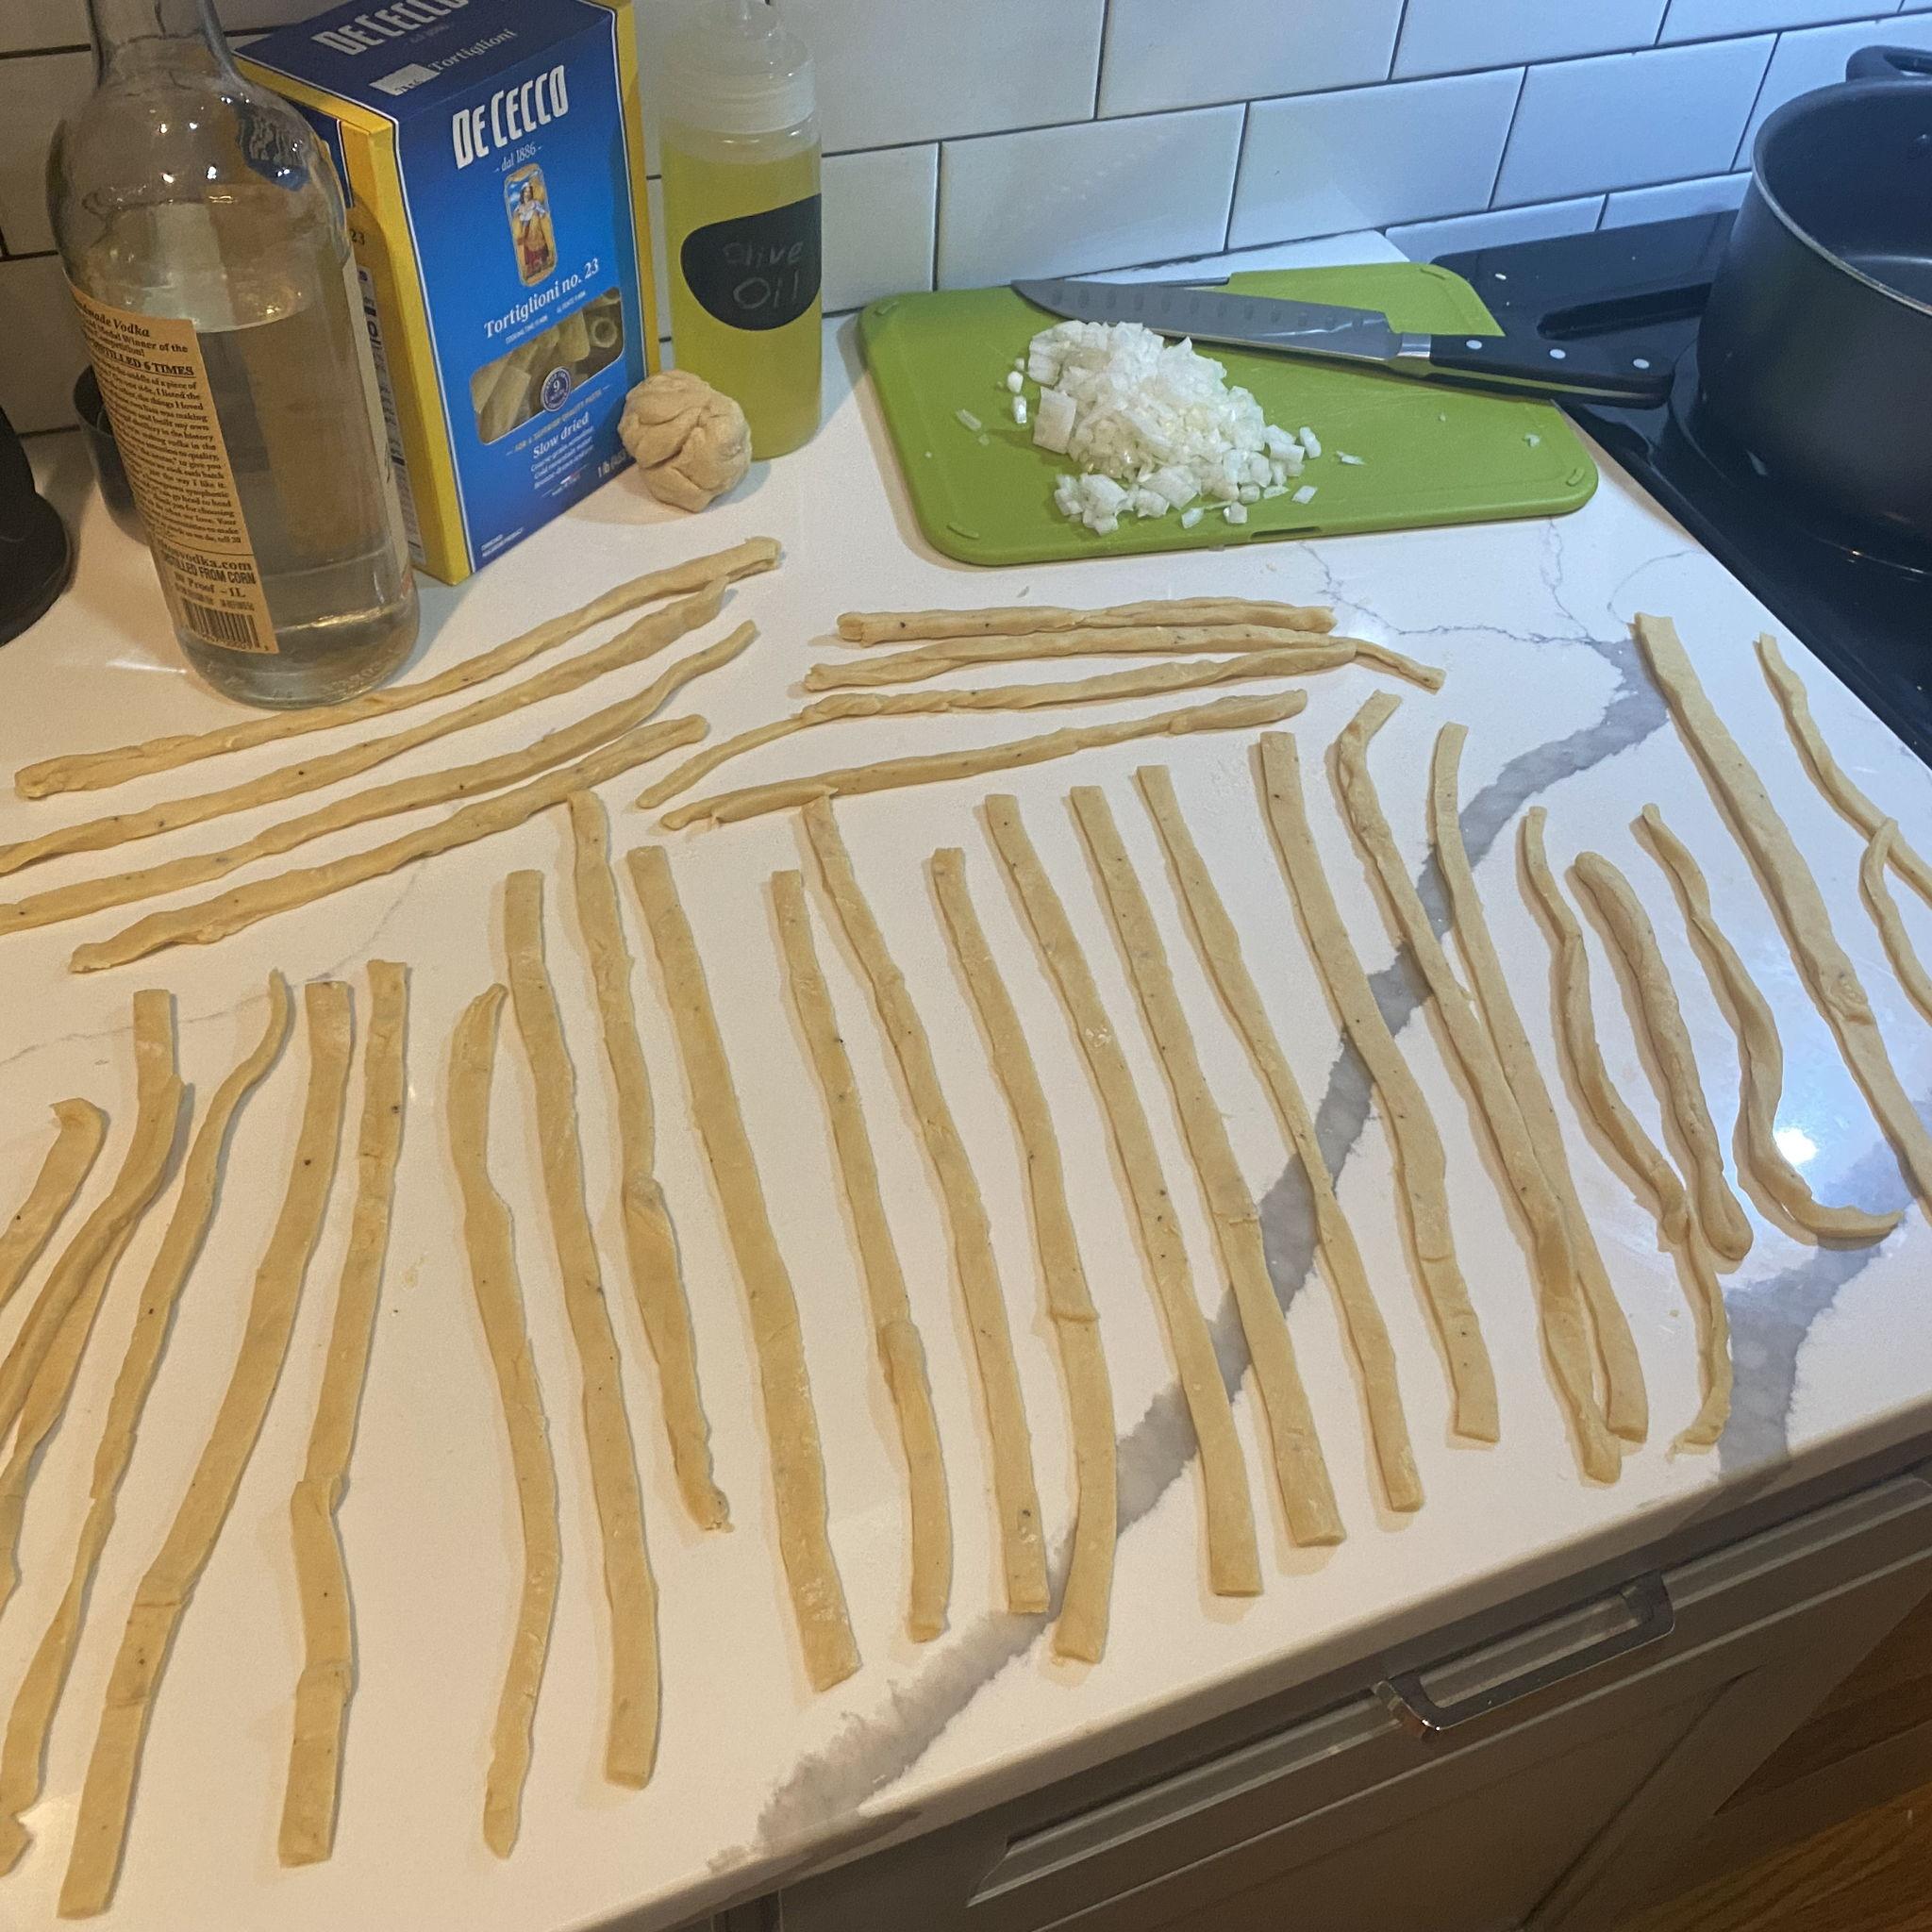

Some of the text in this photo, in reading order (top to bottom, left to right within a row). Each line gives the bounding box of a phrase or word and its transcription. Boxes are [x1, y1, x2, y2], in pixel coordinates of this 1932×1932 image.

[311, 25, 386, 56] DE
[428, 28, 517, 72] Tortiglioni
[452, 65, 569, 171] DE CECCO
[501, 142, 537, 172] dal 1886
[723, 241, 803, 268] Olive
[484, 257, 600, 339] Tortiglioni no. 23
[733, 269, 801, 309] Oil
[113, 318, 150, 338] Vodka
[122, 333, 157, 350] Winner
[158, 342, 170, 353] of
[171, 343, 189, 354] the
[142, 361, 151, 371] 6
[151, 362, 194, 376] TIMES
[553, 380, 561, 393] 9
[532, 434, 559, 459] Slow
[560, 411, 591, 441] dried
[187, 576, 215, 594] Proof
[198, 566, 226, 583] FROM
[226, 571, 257, 586] CORN
